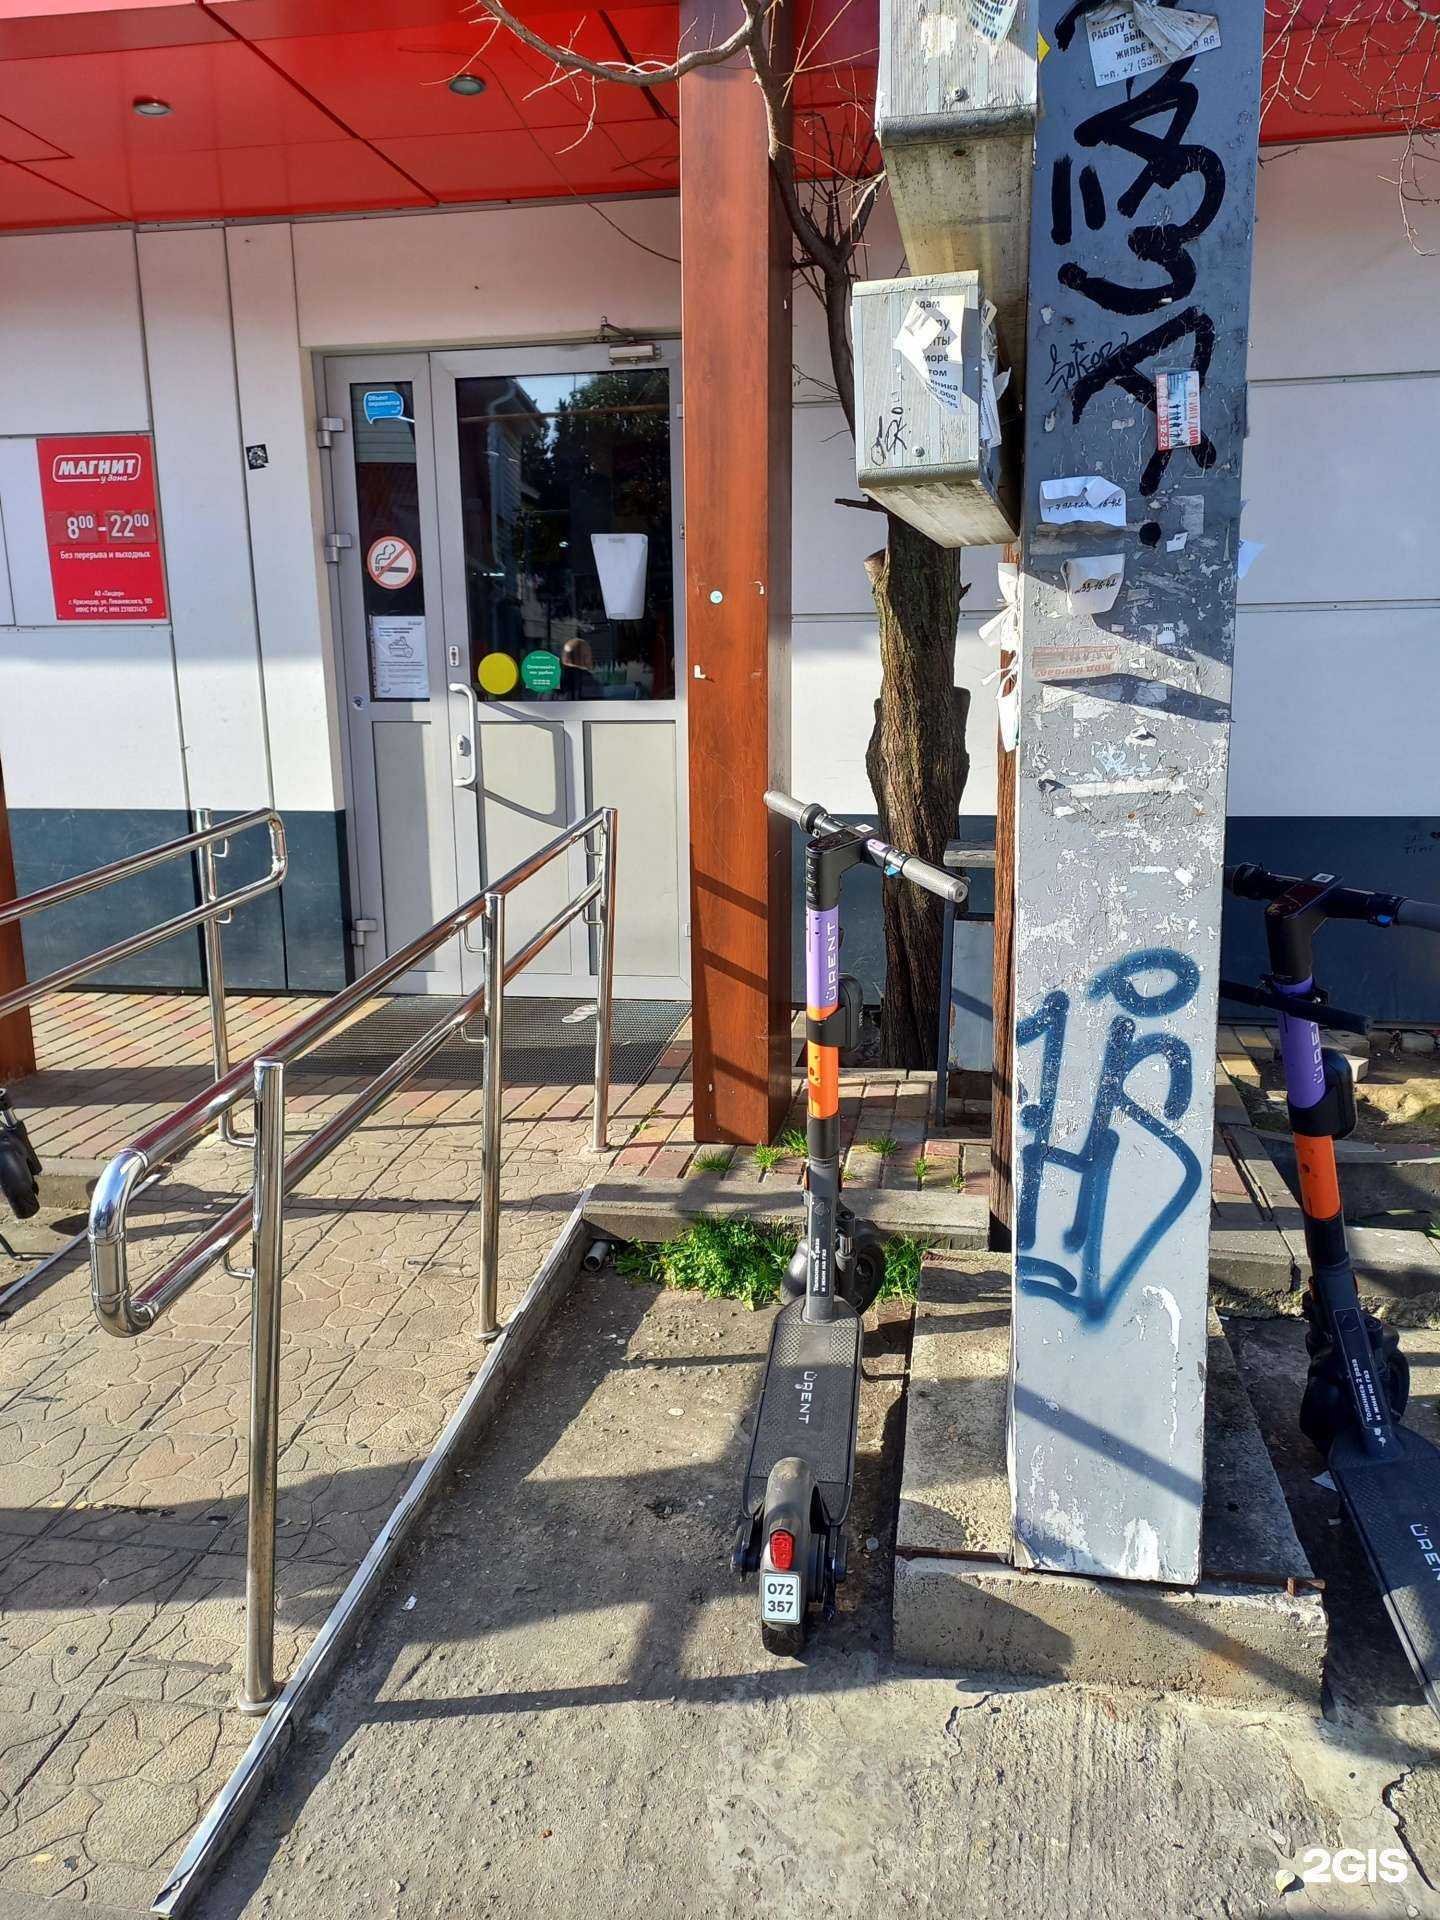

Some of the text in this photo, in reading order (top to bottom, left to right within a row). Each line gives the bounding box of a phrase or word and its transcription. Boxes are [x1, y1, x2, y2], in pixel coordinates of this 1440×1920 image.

[58, 459, 136, 475] МАГНИТ
[1351, 1358, 1362, 1377] раза
[1363, 1369, 1371, 1383] газ
[1367, 1383, 1374, 1394] на
[1370, 1395, 1380, 1413] жми
[767, 1583, 794, 1596] 072
[767, 1600, 794, 1613] 357
